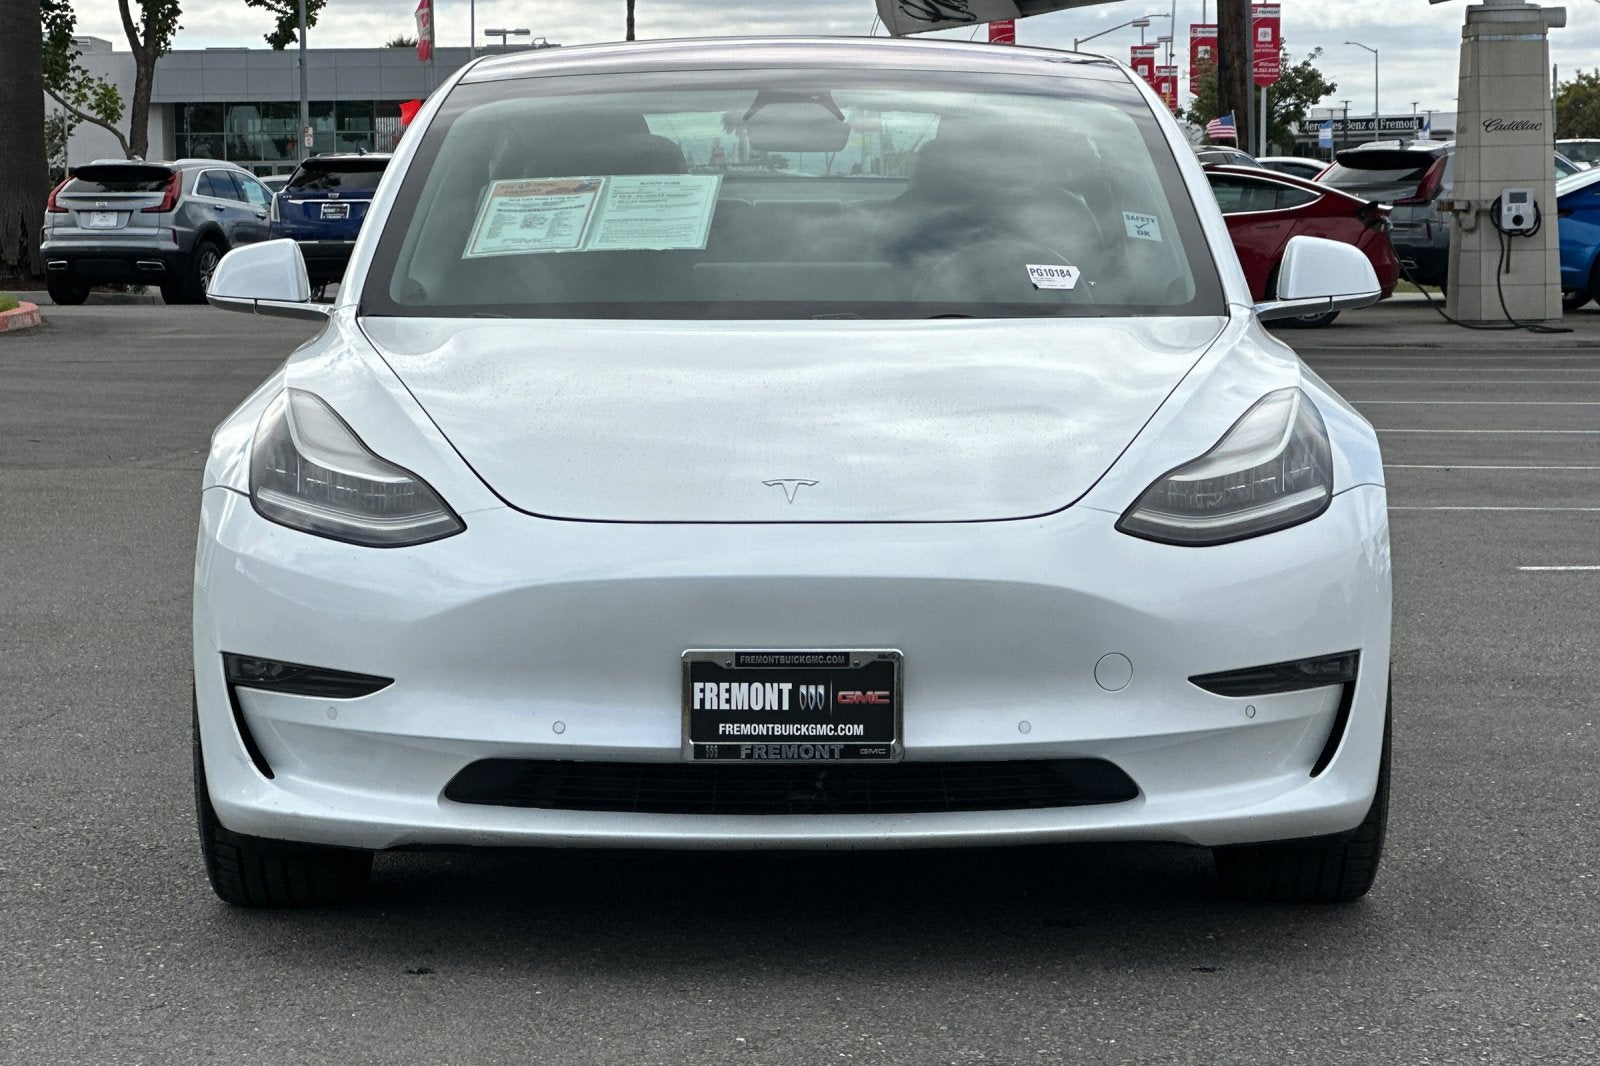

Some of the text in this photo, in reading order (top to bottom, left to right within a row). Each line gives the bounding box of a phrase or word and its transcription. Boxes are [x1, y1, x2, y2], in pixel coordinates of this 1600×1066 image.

[1303, 119, 1366, 131] erces-Benz
[1380, 118, 1420, 130] Fremont
[1482, 118, 1545, 134] Cadillac
[1125, 213, 1155, 223] SAFETY
[1136, 229, 1151, 237] OK
[1029, 267, 1072, 278] PG10184
[739, 655, 845, 664] FREMONTBUICKGMC.COM
[693, 682, 890, 711] FREMONT GMC
[718, 723, 864, 736] FREMONTBUICKGMC.COM
[739, 744, 844, 760] FREMONT
